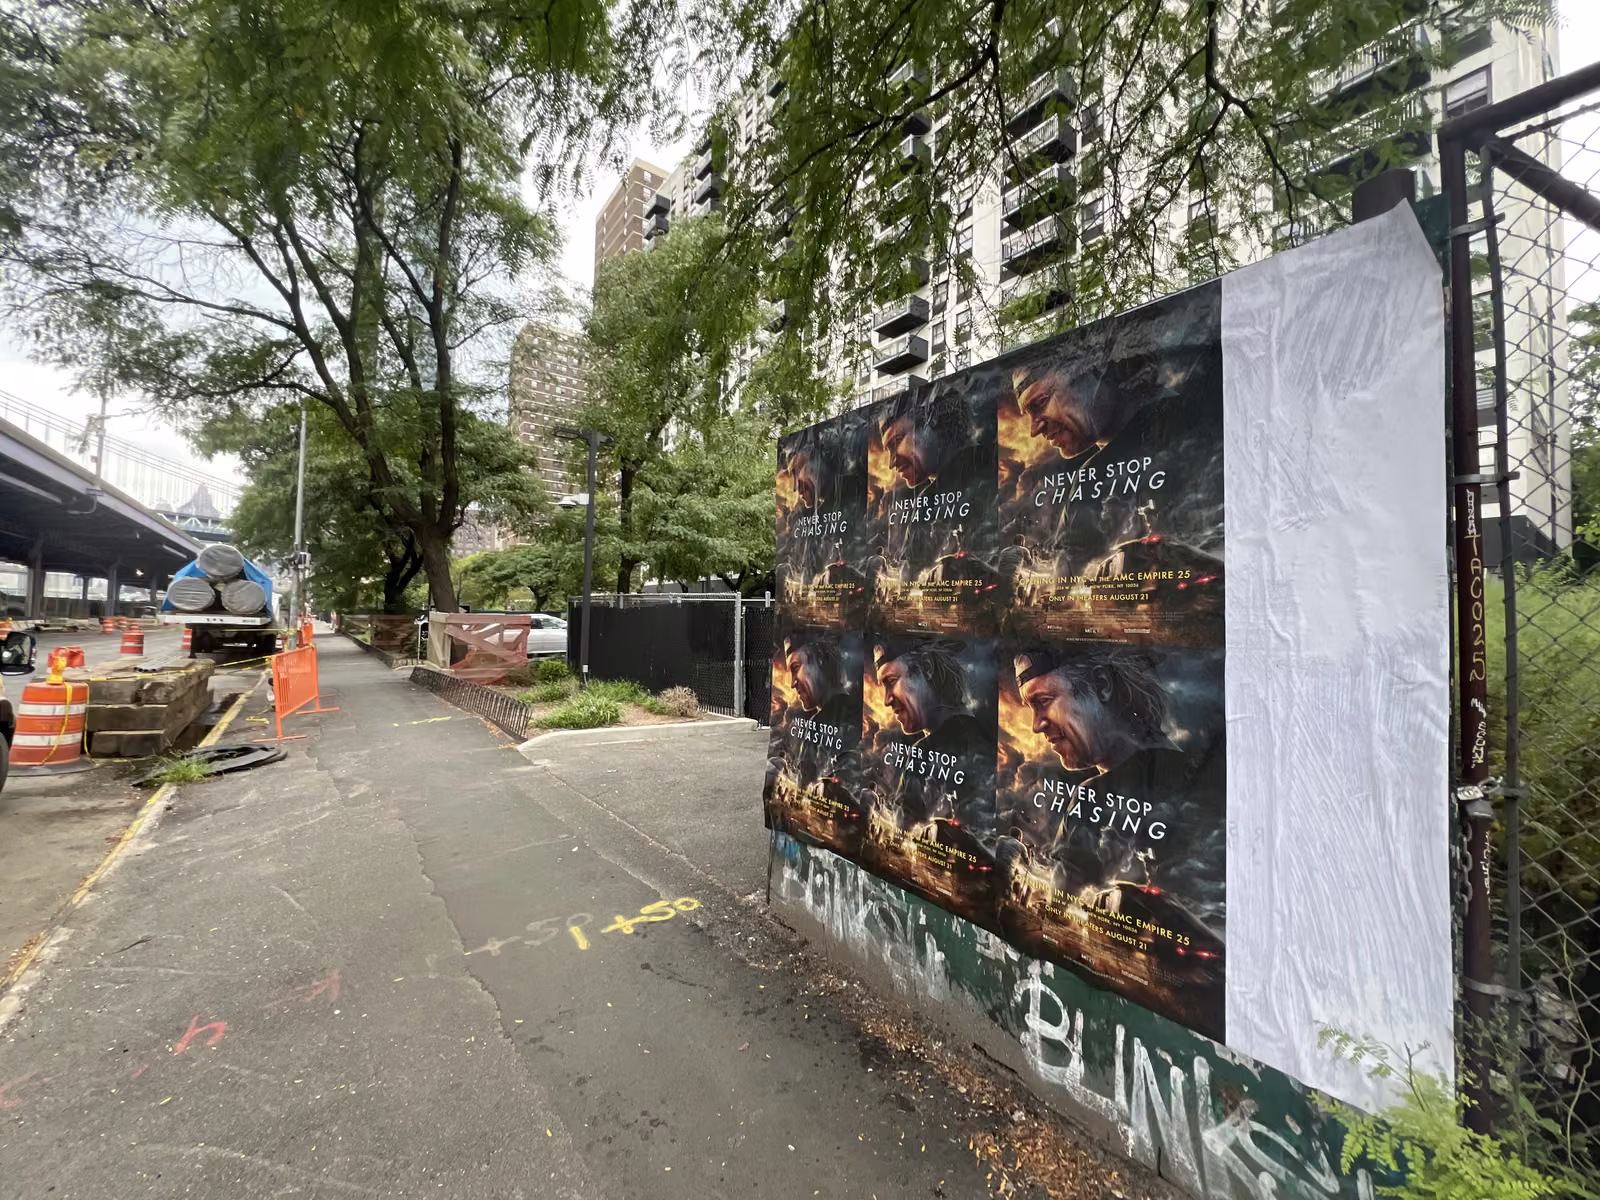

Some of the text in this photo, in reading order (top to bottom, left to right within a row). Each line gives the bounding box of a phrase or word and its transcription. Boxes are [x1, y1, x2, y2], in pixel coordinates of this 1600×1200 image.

[1043, 456, 1152, 488] NEVER STOP
[894, 490, 962, 511] NEVER STOP
[1034, 471, 1166, 507] CHASING
[798, 510, 842, 526] NEVER STOP
[888, 502, 970, 525] CHASING
[793, 520, 848, 539] CHASING
[951, 579, 973, 587] EMPIRE
[974, 579, 983, 587] 25
[1058, 576, 1067, 584] IN
[1070, 575, 1088, 584] NYC
[1112, 572, 1135, 582] AMC
[1137, 570, 1173, 581] EMPIRE
[1177, 569, 1191, 580] 25
[933, 594, 952, 602] AUGUST
[1067, 594, 1076, 602] IN
[1109, 593, 1138, 601] AUGUST
[1139, 593, 1149, 601] 21
[794, 716, 839, 736] NEVER STOP
[790, 726, 842, 750] CHASING
[890, 741, 957, 768] NEVER STOP
[883, 752, 965, 785] CHASING
[1043, 778, 1153, 817] NEVER STOP
[1033, 792, 1167, 840] CHASING
[928, 855, 946, 867] AUGUST
[929, 840, 944, 852] AMC
[945, 845, 967, 860] EMPIRE
[968, 854, 977, 864] 25
[1045, 904, 1062, 916] ONLY
[1063, 911, 1072, 920] IN
[1105, 930, 1138, 946] AUGUST
[1138, 941, 1148, 951] 21
[1054, 888, 1064, 898] IN
[1066, 893, 1084, 906] NYC
[1108, 911, 1133, 925] AMC
[1136, 918, 1173, 940] EMPIRE
[1176, 933, 1190, 946] 25
